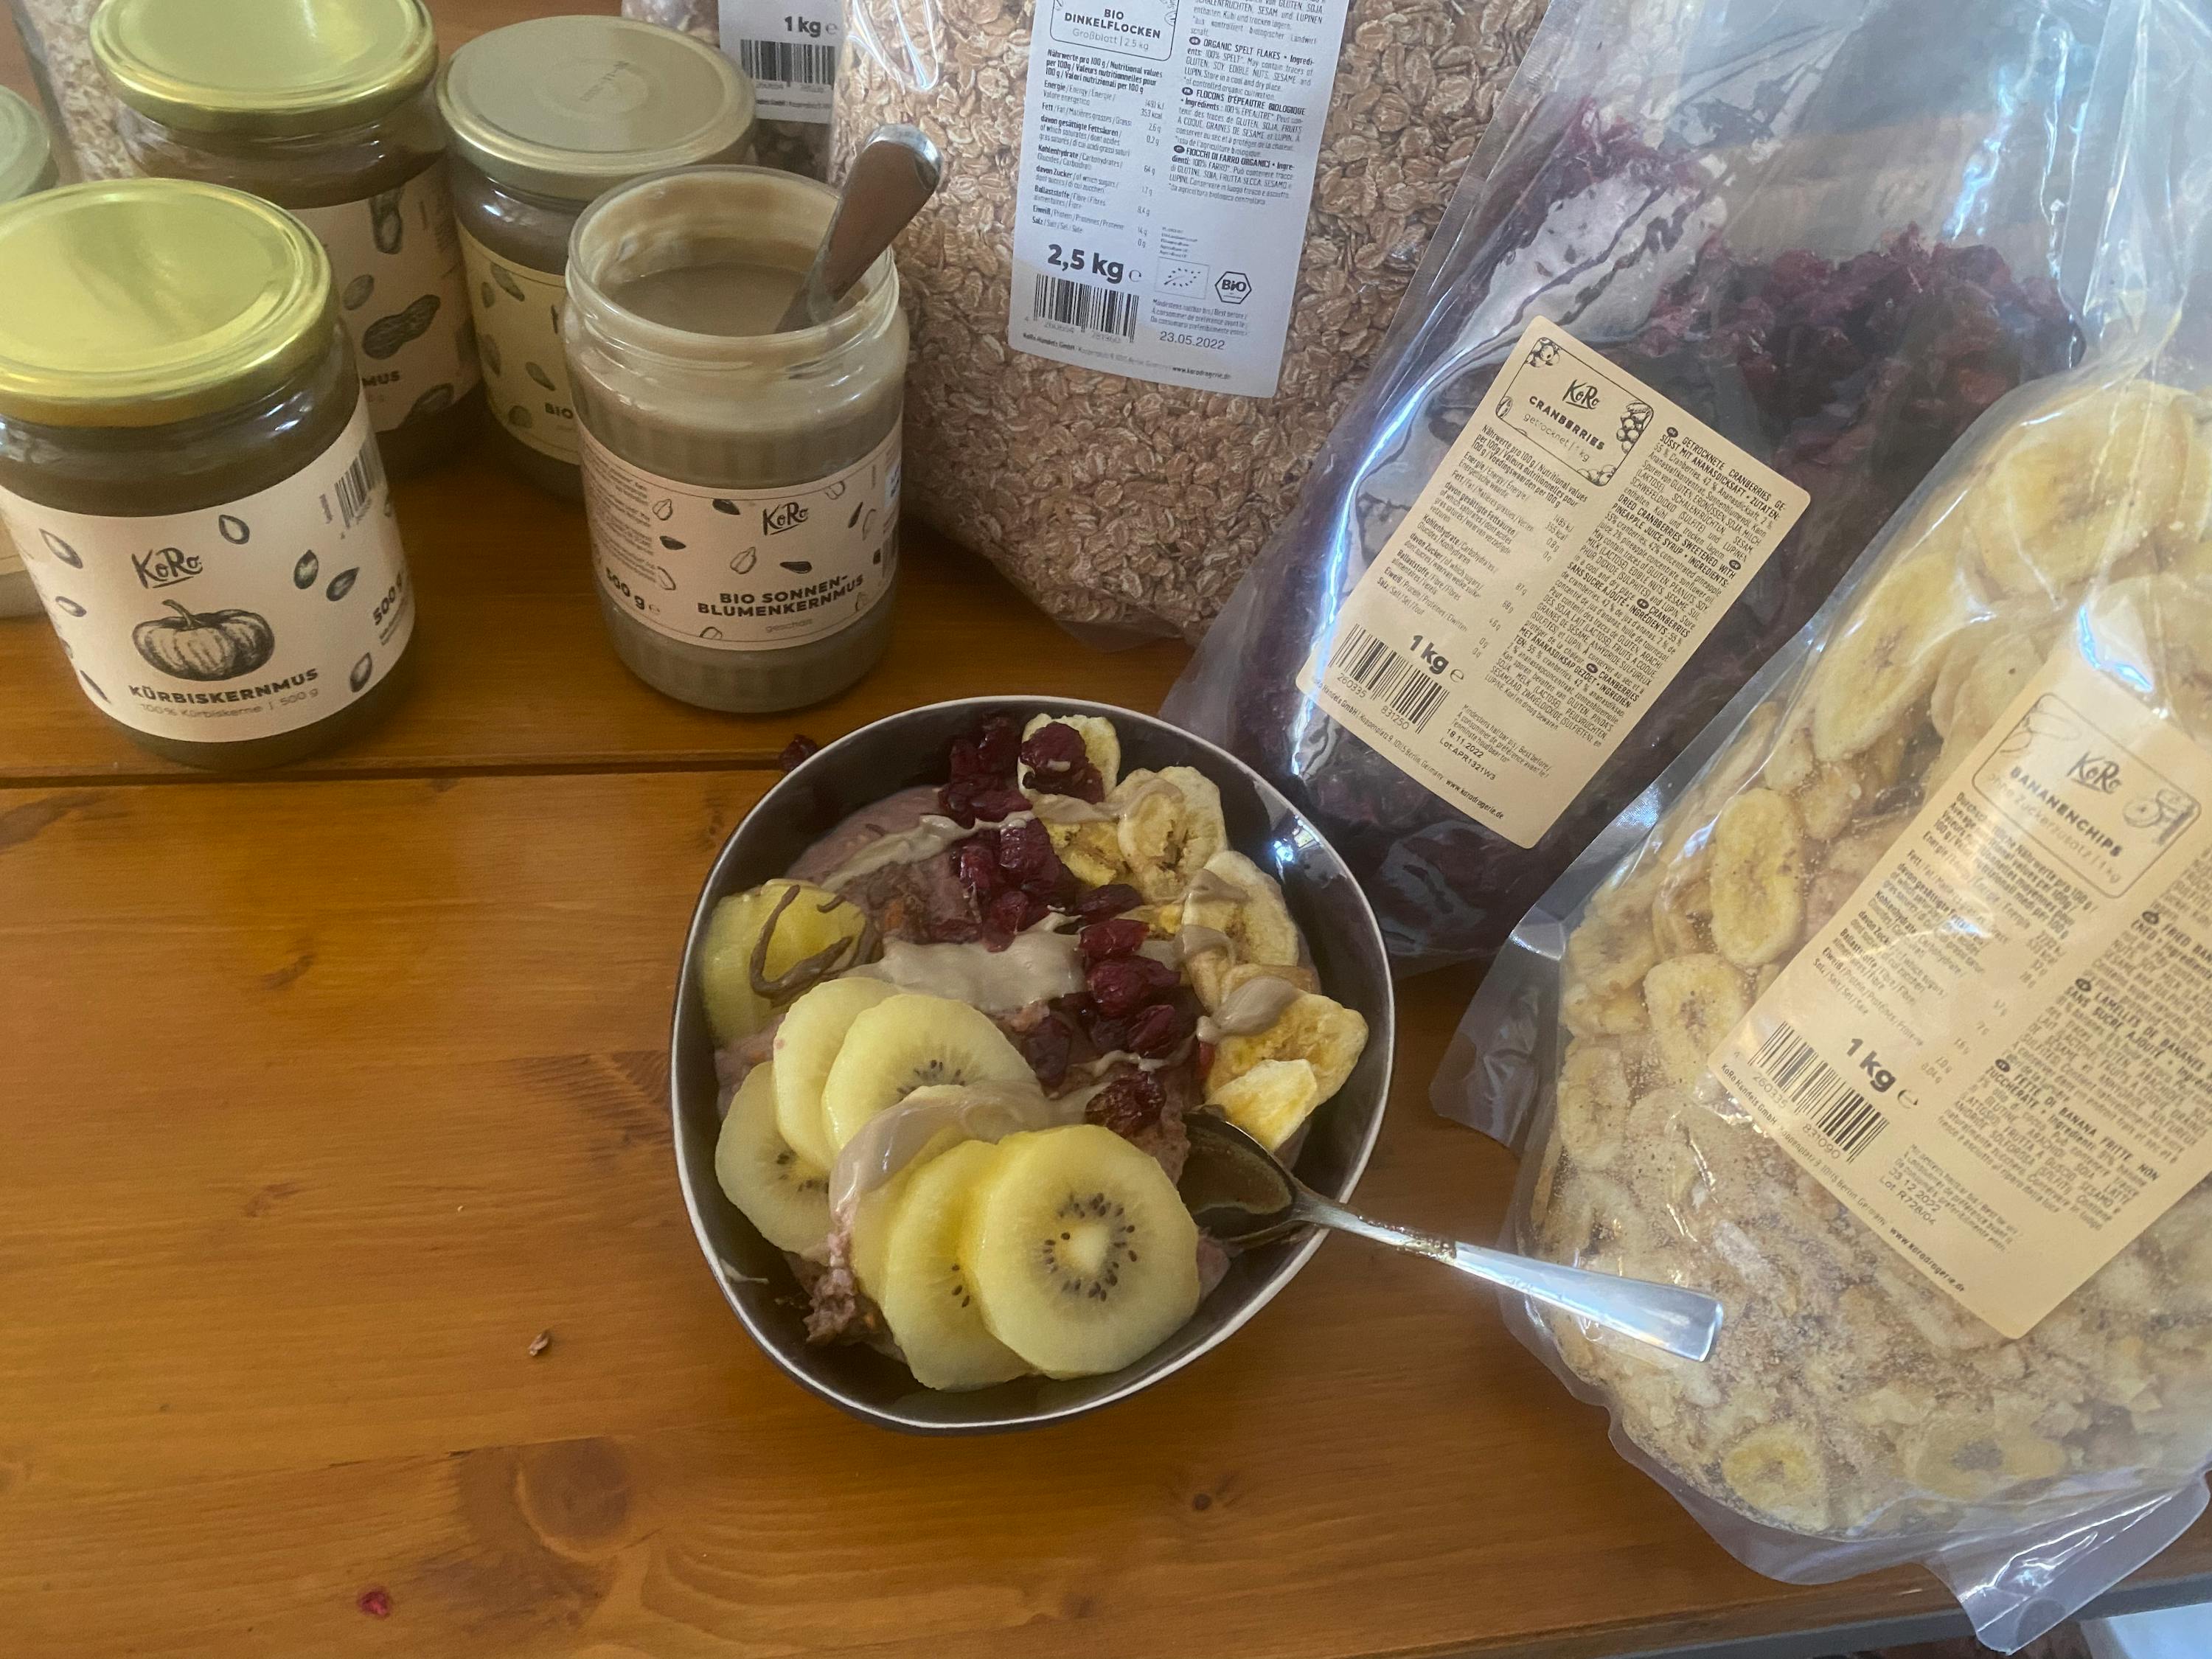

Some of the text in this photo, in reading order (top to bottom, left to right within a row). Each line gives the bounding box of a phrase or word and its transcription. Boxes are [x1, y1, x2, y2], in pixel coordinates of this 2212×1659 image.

[784, 16, 793, 32] 1
[799, 16, 821, 37] kg
[1063, 13, 1161, 38] DINKELFLOCKEN
[1104, 9, 1124, 20] BIO
[1046, 59, 1056, 68] per
[1075, 63, 1097, 74] Valeurs
[1079, 55, 1089, 64] pro
[1091, 57, 1101, 66] 100
[1143, 68, 1163, 77] values
[1203, 38, 1281, 60] ORGANIC SPELT FLAKES
[1040, 115, 1057, 125] davon
[1196, 89, 1225, 102] FLOCONS
[1268, 102, 1305, 116] BIOLOGIQUE
[1037, 144, 1079, 159] Kohlenhydrate
[1186, 147, 1270, 169] FIOCCHI FARRO ORGANICI
[1036, 165, 1073, 178] davon Zucker
[1046, 243, 1086, 274] 2,5
[1091, 251, 1125, 285] kg
[1159, 329, 1225, 352] 23.05.2022
[544, 402, 574, 420] BIO
[1562, 378, 1601, 413] KoRo
[1523, 412, 1590, 462] getrocknet kg
[1528, 395, 1605, 450] CRANBERRIES
[1462, 451, 1506, 485] Energie Energy
[1475, 433, 1578, 507] per 100g Valeurs nutritionnelles pour
[1481, 424, 1588, 502] Nährwerte pro 100 Nutritional values
[1487, 452, 1546, 497] Voedingswaarden per
[1681, 437, 1772, 501] GETROCKNETE CRANBERRIES
[1444, 481, 1488, 515] davon gesättigte
[1678, 447, 1781, 521] MIT ANANASDICKSAFT ZUTATEN:
[762, 501, 809, 536] KoRo
[1420, 513, 1461, 545] Kohlenhydrate
[1668, 518, 1682, 529] und
[1682, 526, 1705, 546] trocken
[1409, 532, 1443, 560] davon Zucker
[1591, 527, 1641, 566] May contain traces
[1610, 502, 1729, 588] PINEAPPLE JUICE SYRUP INGREDIENTS:
[1617, 493, 1736, 580] DRIED CRANBBERRIES SWEETENED WITH
[131, 546, 203, 588] KoRo
[1396, 549, 1430, 577] Ballaststoffe
[1566, 561, 1585, 577] SANS
[1582, 571, 1604, 590] SUCRE
[1659, 551, 1722, 597] concentrated pineapple
[634, 595, 645, 610] g
[698, 574, 864, 617] BLUMENKERNMUS
[720, 574, 848, 604] BIO SONNEN-
[1648, 605, 1691, 637] CRANBERRIES
[1408, 633, 1423, 651] 1
[1419, 641, 1450, 675] kg
[1518, 626, 1597, 684] MET ANANASDIKSAP GEZOET
[128, 668, 319, 704] KÜRBISKERNMUS
[1336, 672, 1410, 730] 260335 831250
[1598, 671, 1639, 702] CRANBERRIES
[1340, 699, 1358, 716] GmbH
[2066, 749, 2125, 799] KoRo
[1445, 779, 1503, 820] www.korodrogerie.de
[2009, 766, 2124, 858] BANANENCHIPS
[2065, 985, 2091, 1008] SANS
[1845, 1036, 1863, 1057] 1
[1857, 1049, 1898, 1094] kg
[1985, 1065, 2039, 1110] ZUCCHERATE
[1751, 1071, 1841, 1160] 260335 831090
[2058, 1105, 2097, 1138] BANANA
[2100, 1135, 2133, 1163] FRITTE
[2138, 1164, 2160, 1182] NON
